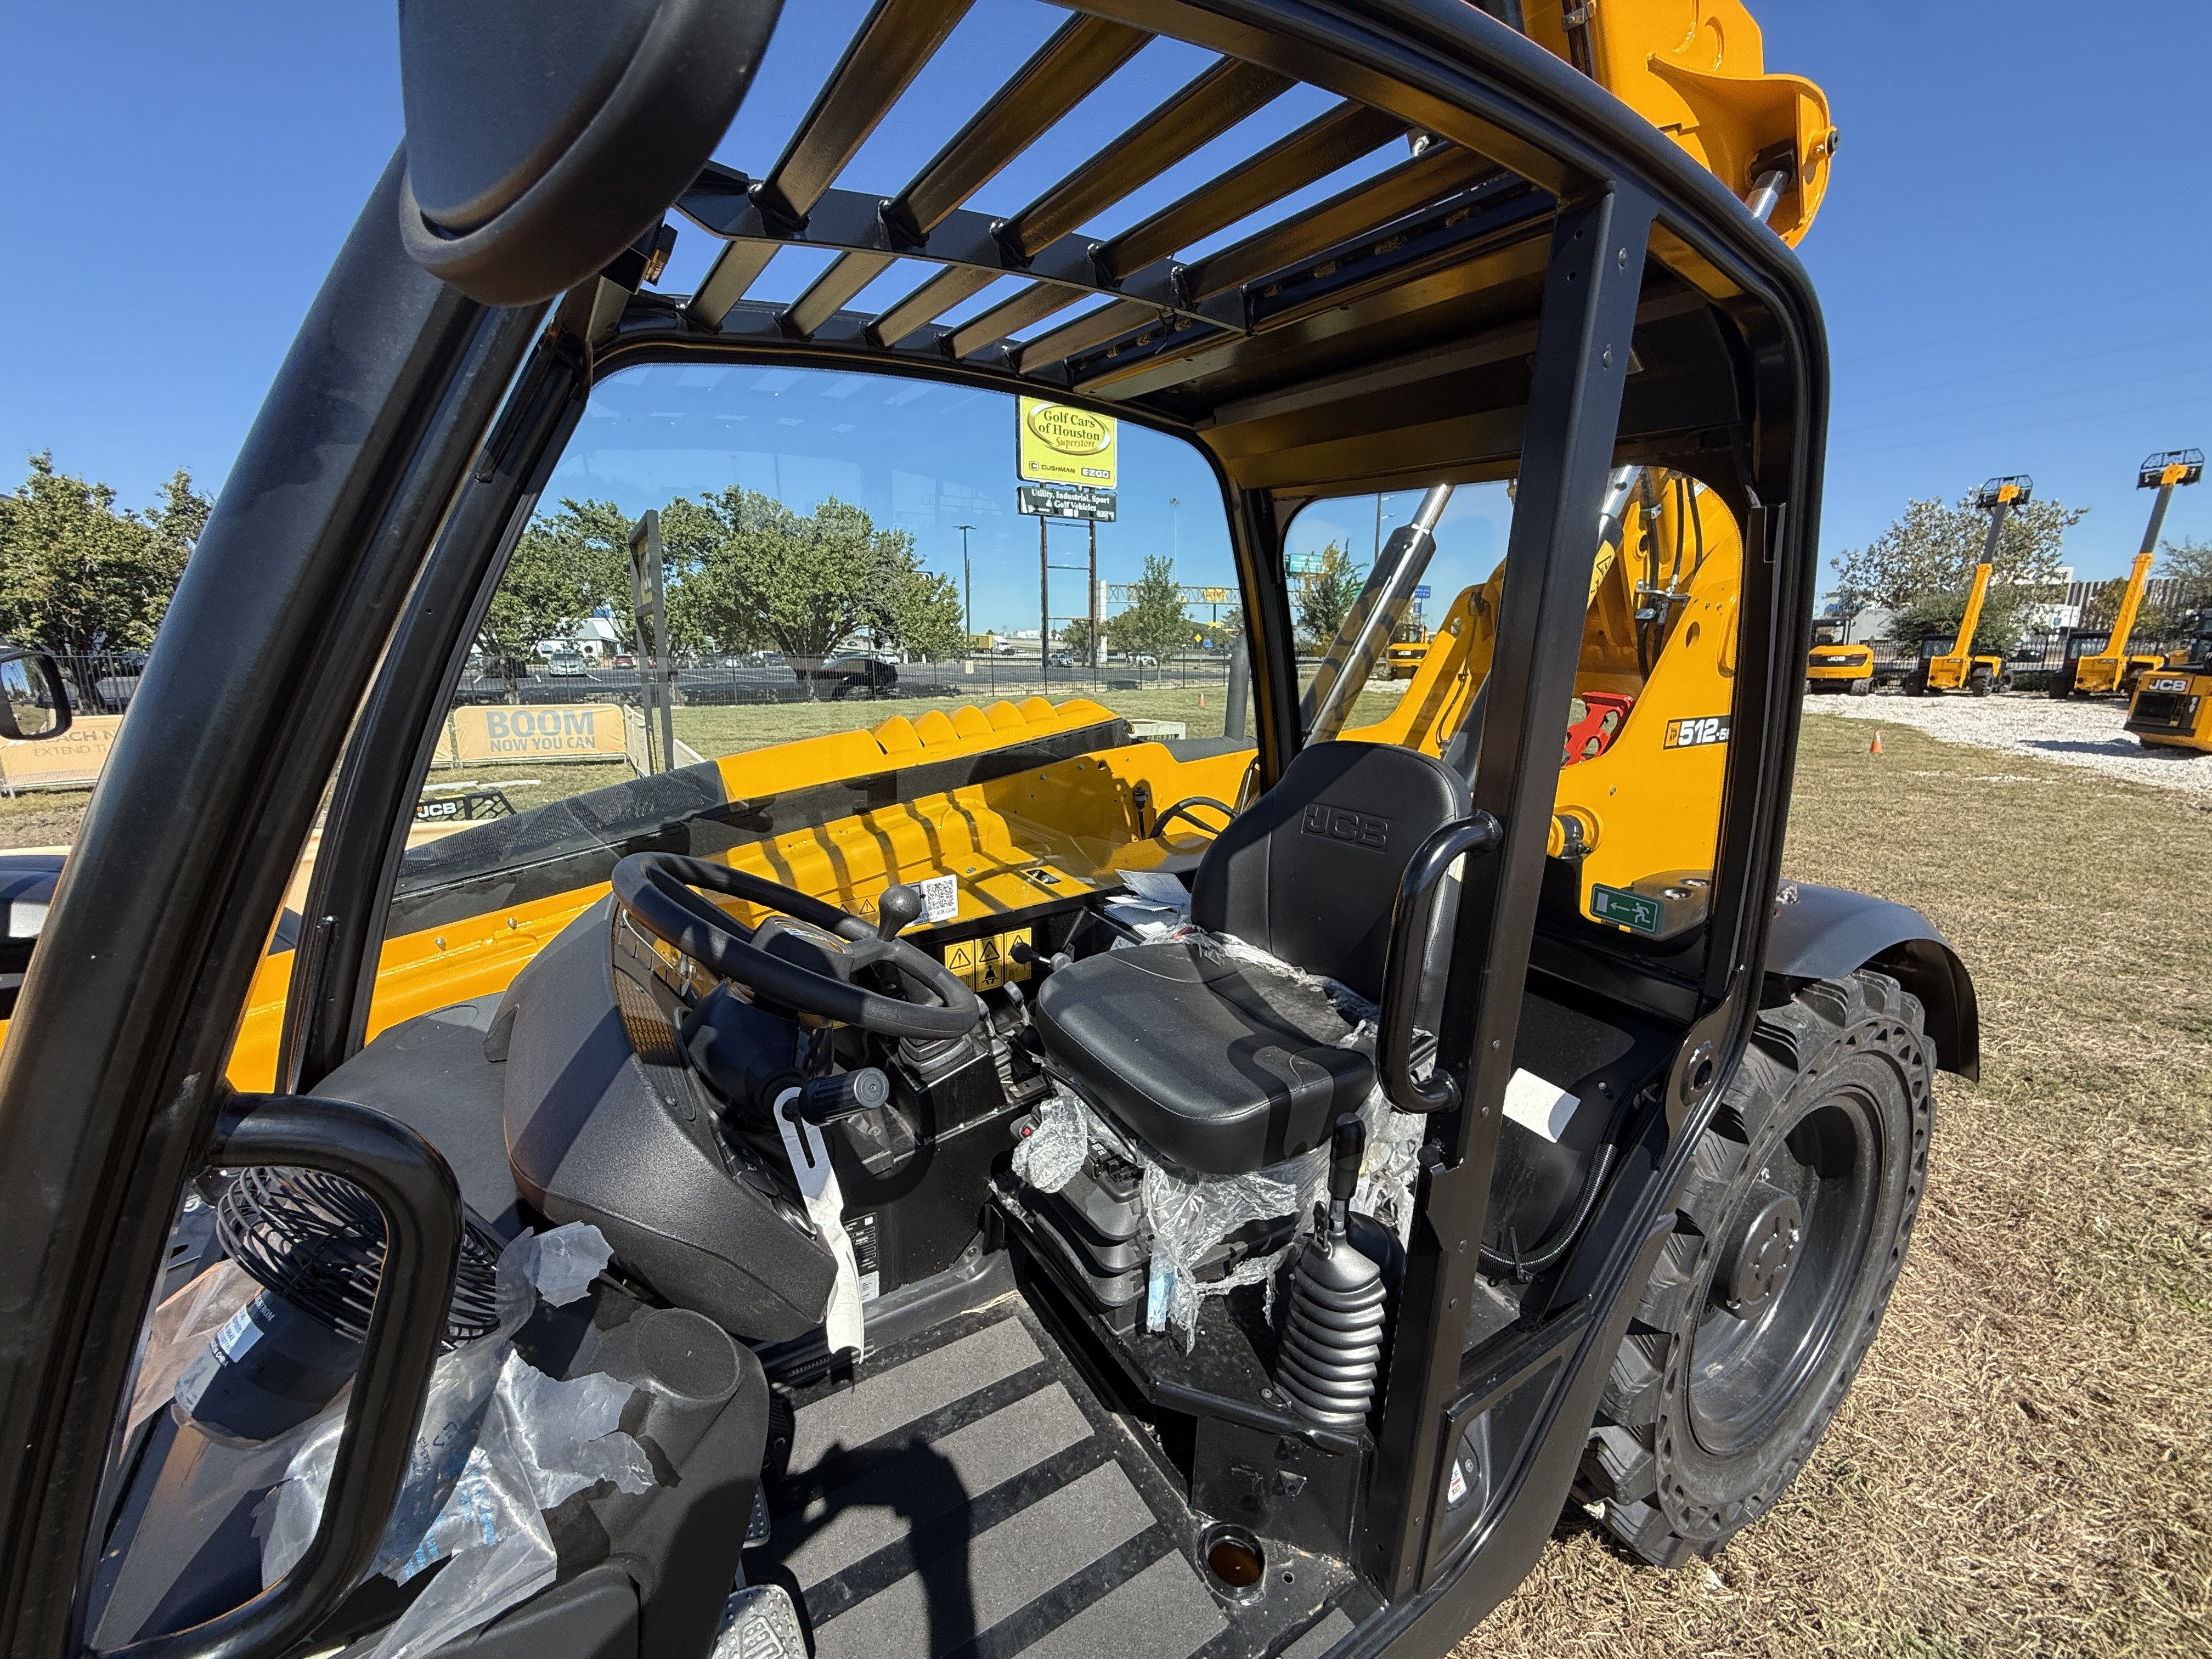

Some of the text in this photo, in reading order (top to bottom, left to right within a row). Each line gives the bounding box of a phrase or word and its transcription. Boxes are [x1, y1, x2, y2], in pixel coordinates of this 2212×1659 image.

[1043, 410, 1095, 428] Golf Cars
[1039, 423, 1100, 441] of Houston
[1056, 437, 1096, 449] Superstore
[1041, 464, 1075, 473] CUSHMAN
[1031, 488, 1110, 505] Utility, Industrial, Sport
[1046, 499, 1097, 511] & Golf Vehicles
[2148, 679, 2187, 691] JCB
[486, 709, 594, 738] BOOM
[35, 745, 91, 757] EXTEND
[490, 736, 596, 753] NOW YOU CAN
[418, 802, 456, 818] JCB
[1305, 806, 1388, 848] JCB
